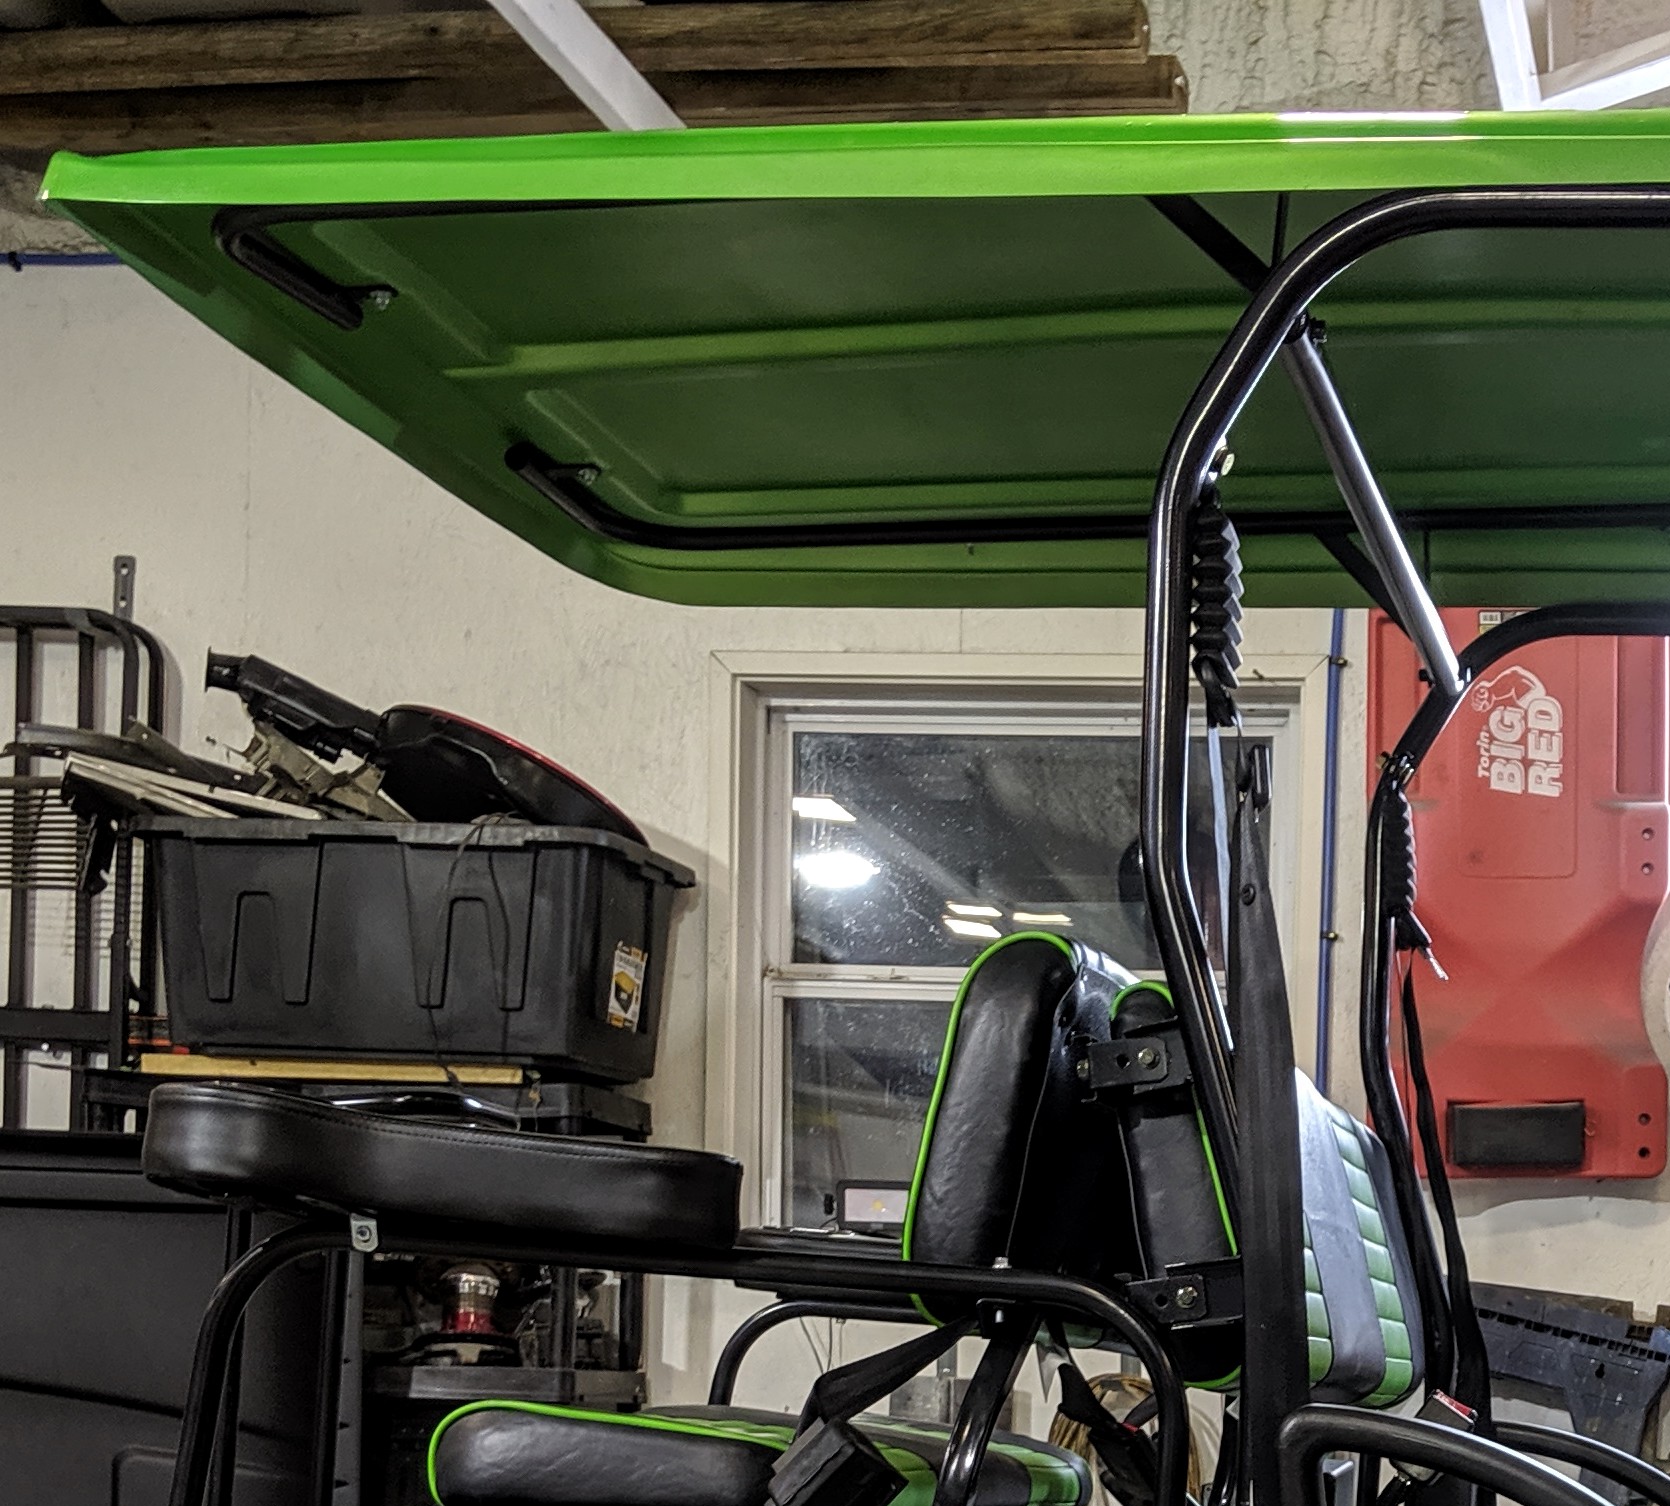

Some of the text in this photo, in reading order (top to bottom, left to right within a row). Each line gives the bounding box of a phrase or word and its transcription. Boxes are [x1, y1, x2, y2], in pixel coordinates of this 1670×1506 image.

[1476, 730, 1491, 778] Torin
[1488, 705, 1525, 795] BIG
[1527, 695, 1563, 797] RED
